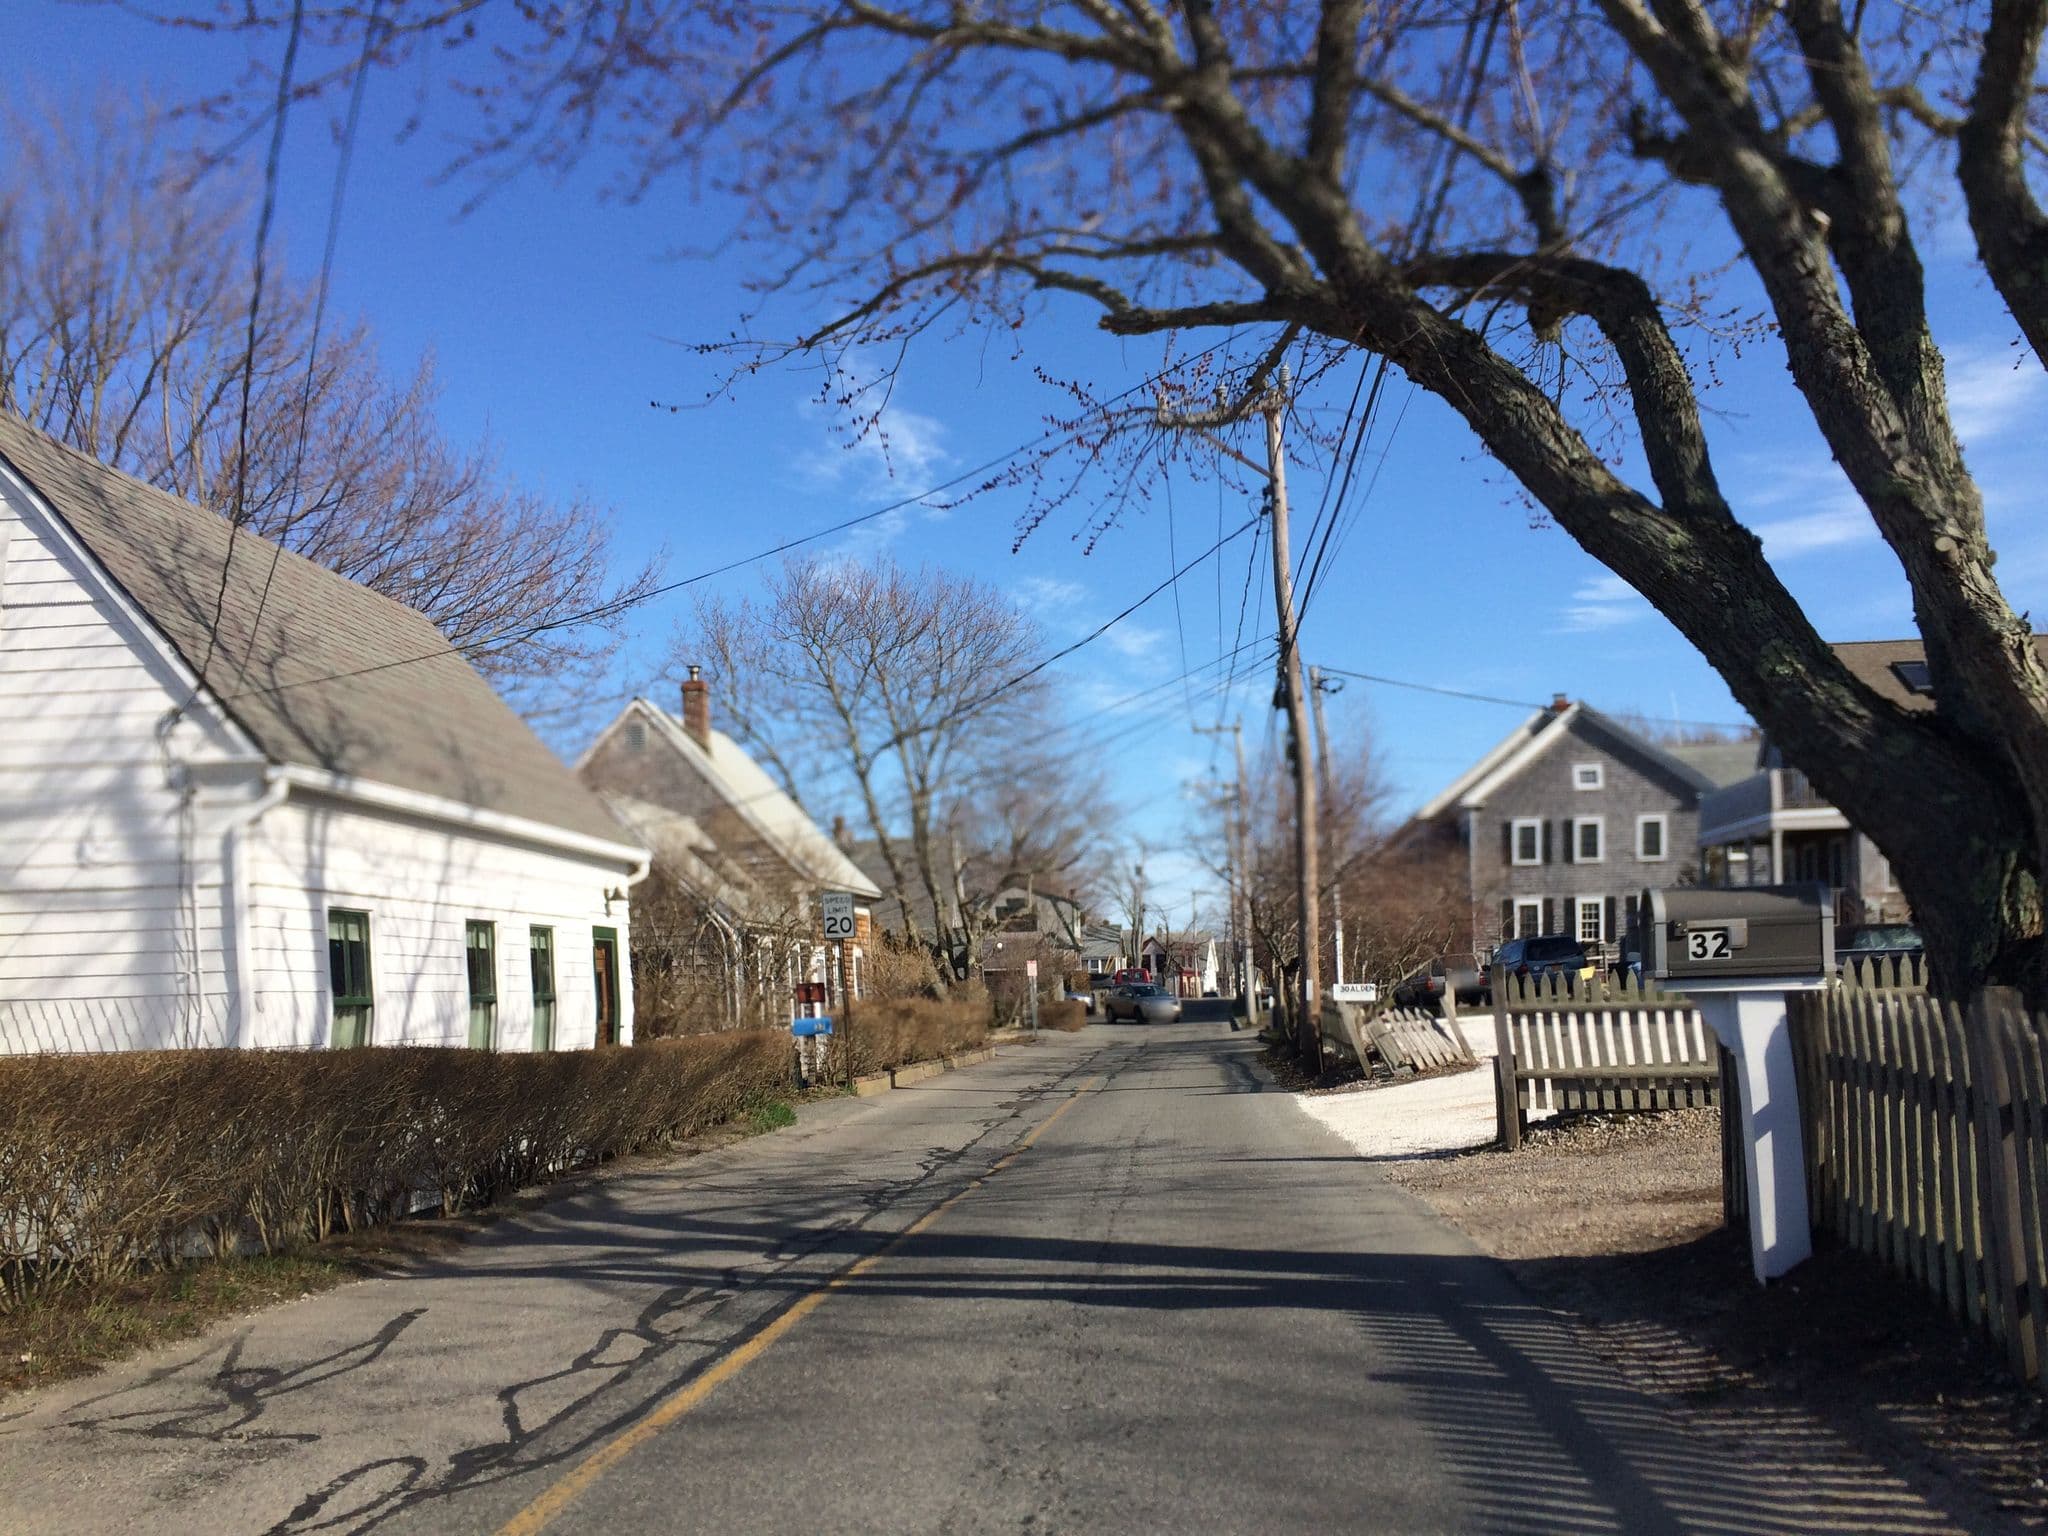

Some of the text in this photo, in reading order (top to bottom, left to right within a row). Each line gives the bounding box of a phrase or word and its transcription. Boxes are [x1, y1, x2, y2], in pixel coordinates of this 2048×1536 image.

[824, 896, 850, 905] SPEED
[827, 906, 848, 914] LIMIT
[826, 917, 852, 934] 20
[1691, 933, 1729, 958] 32
